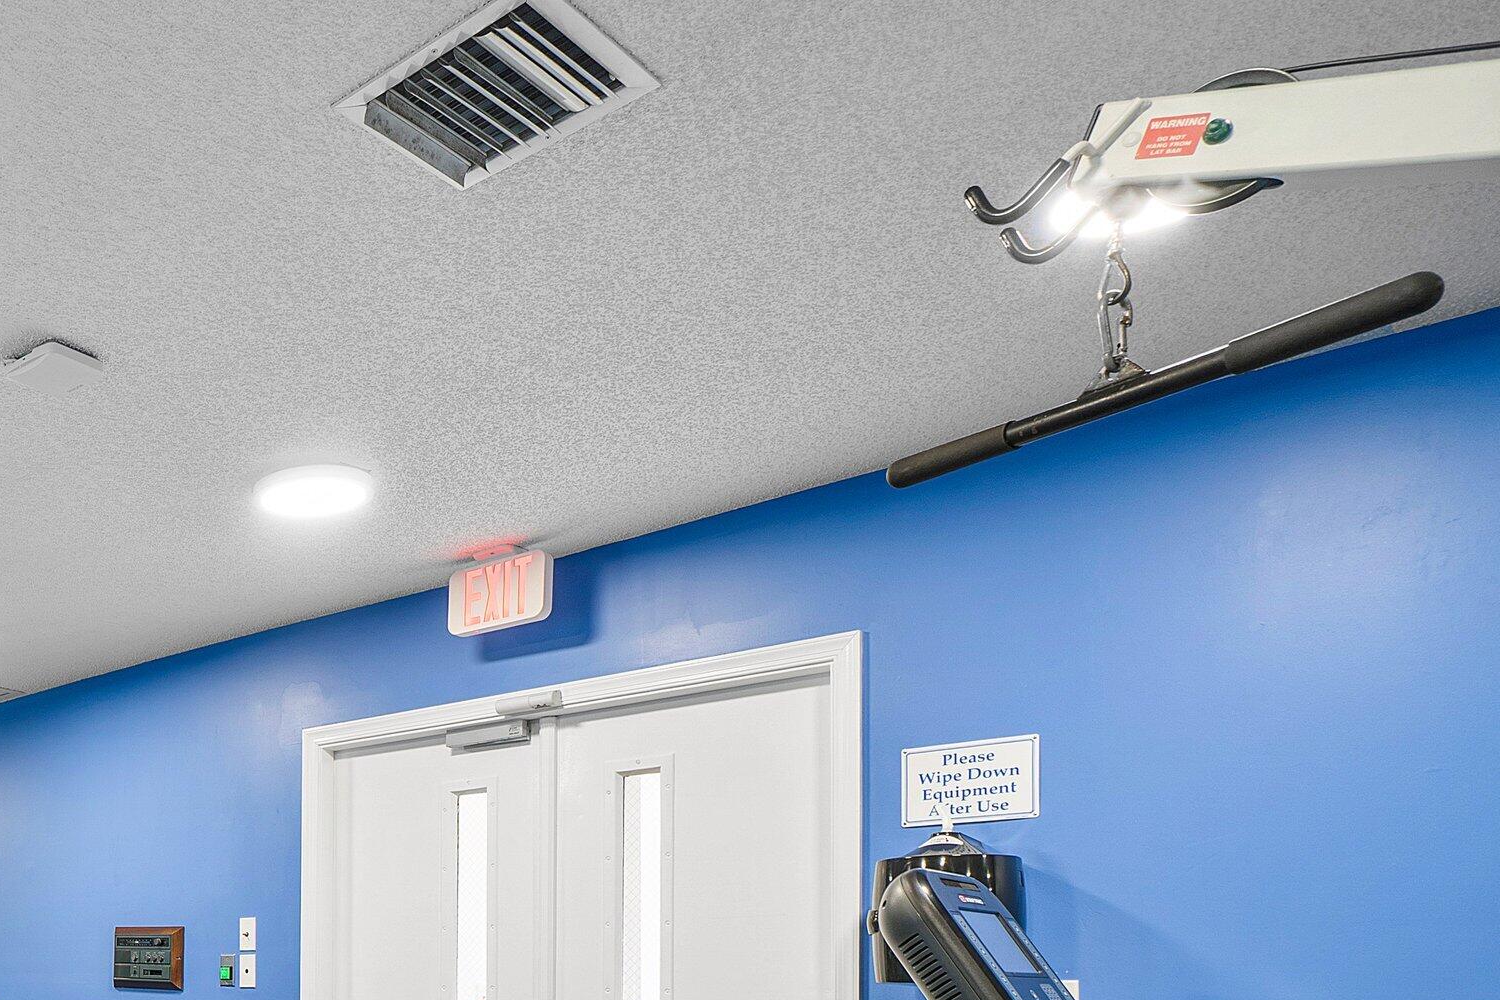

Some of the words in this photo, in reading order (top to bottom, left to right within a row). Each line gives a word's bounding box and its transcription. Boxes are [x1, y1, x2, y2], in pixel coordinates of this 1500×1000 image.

[1150, 116, 1207, 130] WARNING
[1169, 134, 1187, 142] NOT
[463, 554, 533, 627] EXIT
[942, 752, 995, 766] Please
[918, 771, 962, 786] Wipe
[967, 766, 1020, 780] Down
[922, 781, 1017, 804] Equipment
[928, 803, 972, 817] Ater
[977, 800, 1010, 813] Use
